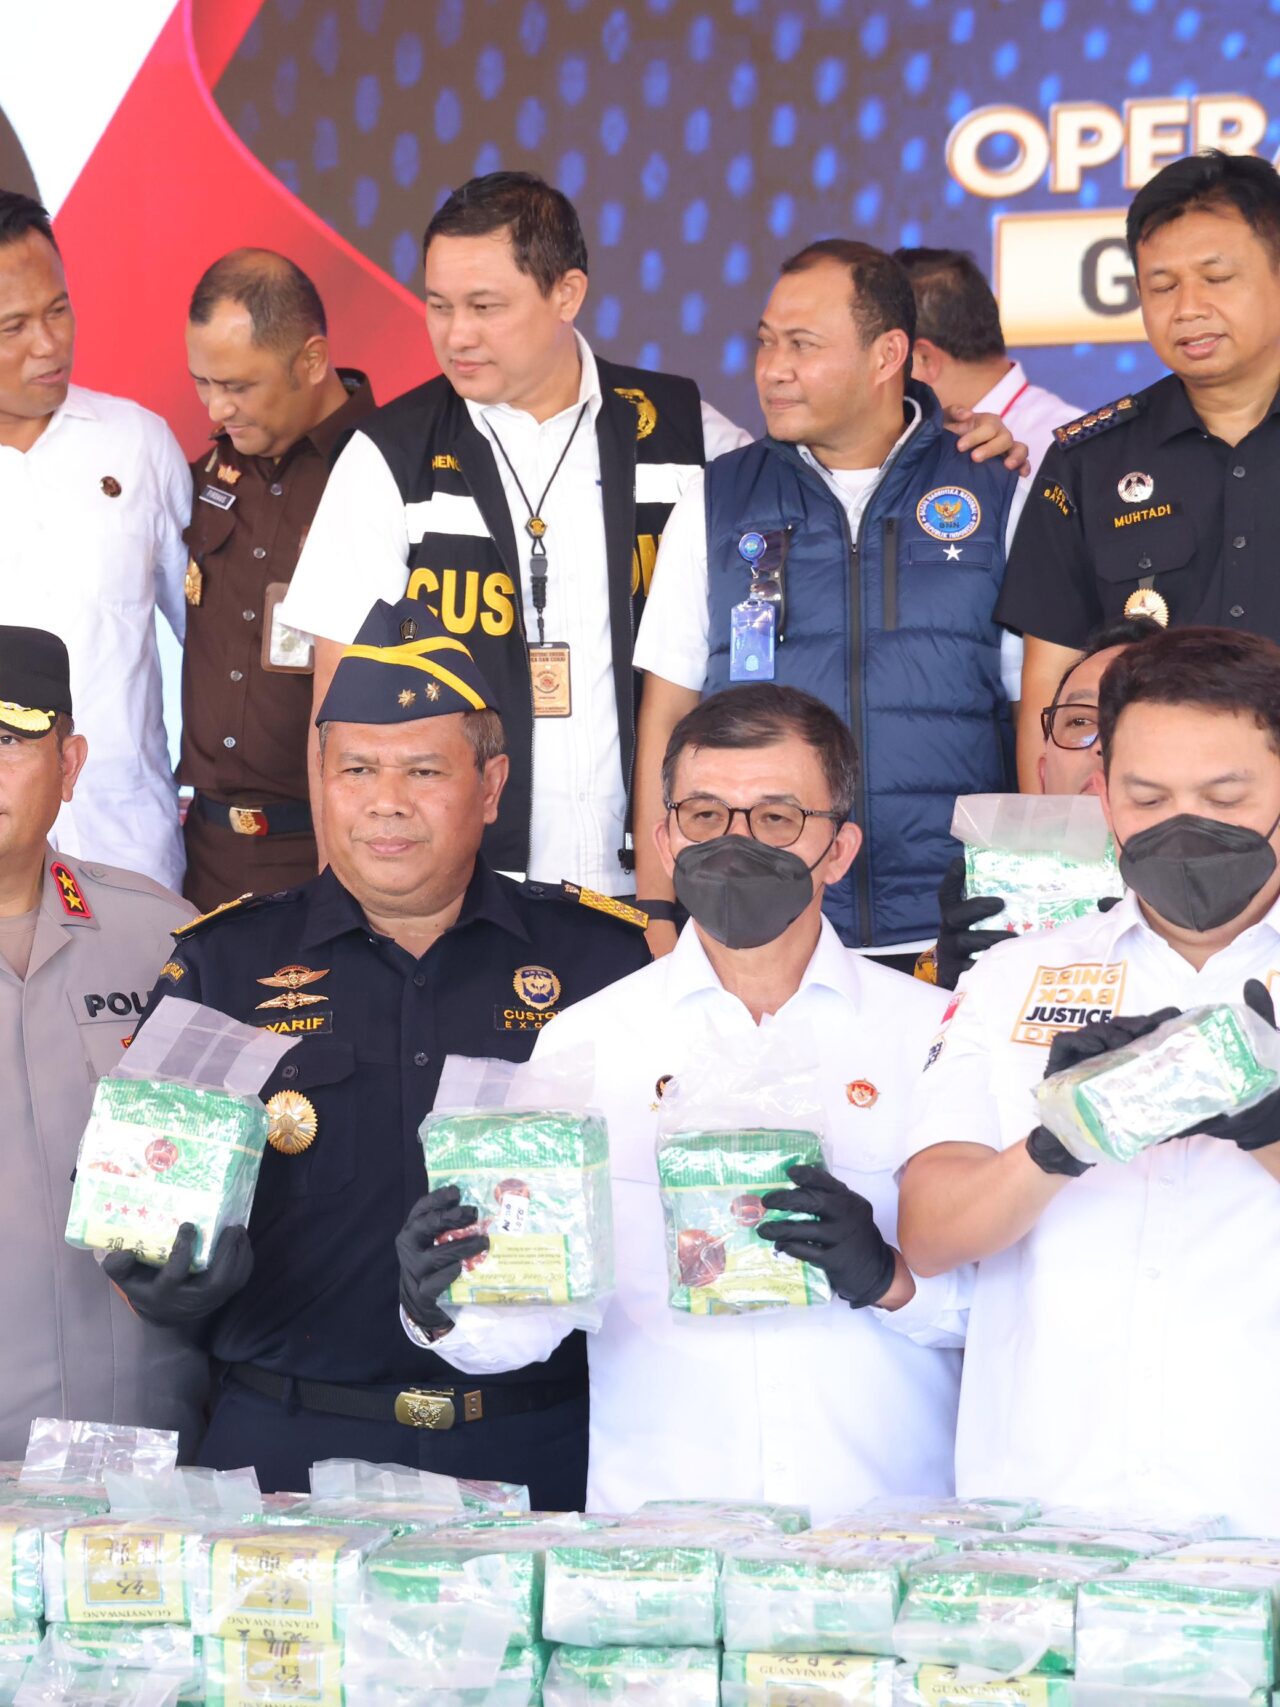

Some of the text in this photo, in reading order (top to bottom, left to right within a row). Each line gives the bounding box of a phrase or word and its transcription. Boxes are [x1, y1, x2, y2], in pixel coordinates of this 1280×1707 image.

[945, 94, 1280, 197] OPER
[1043, 488, 1069, 515] BATAM
[1114, 503, 1173, 529] MUHTADI
[1040, 968, 1120, 986] BRING
[83, 991, 152, 1018] POL
[1025, 1006, 1113, 1024] JUSTICE
[260, 1017, 325, 1034] YARIF
[759, 1665, 847, 1680] GUANYINWAN
